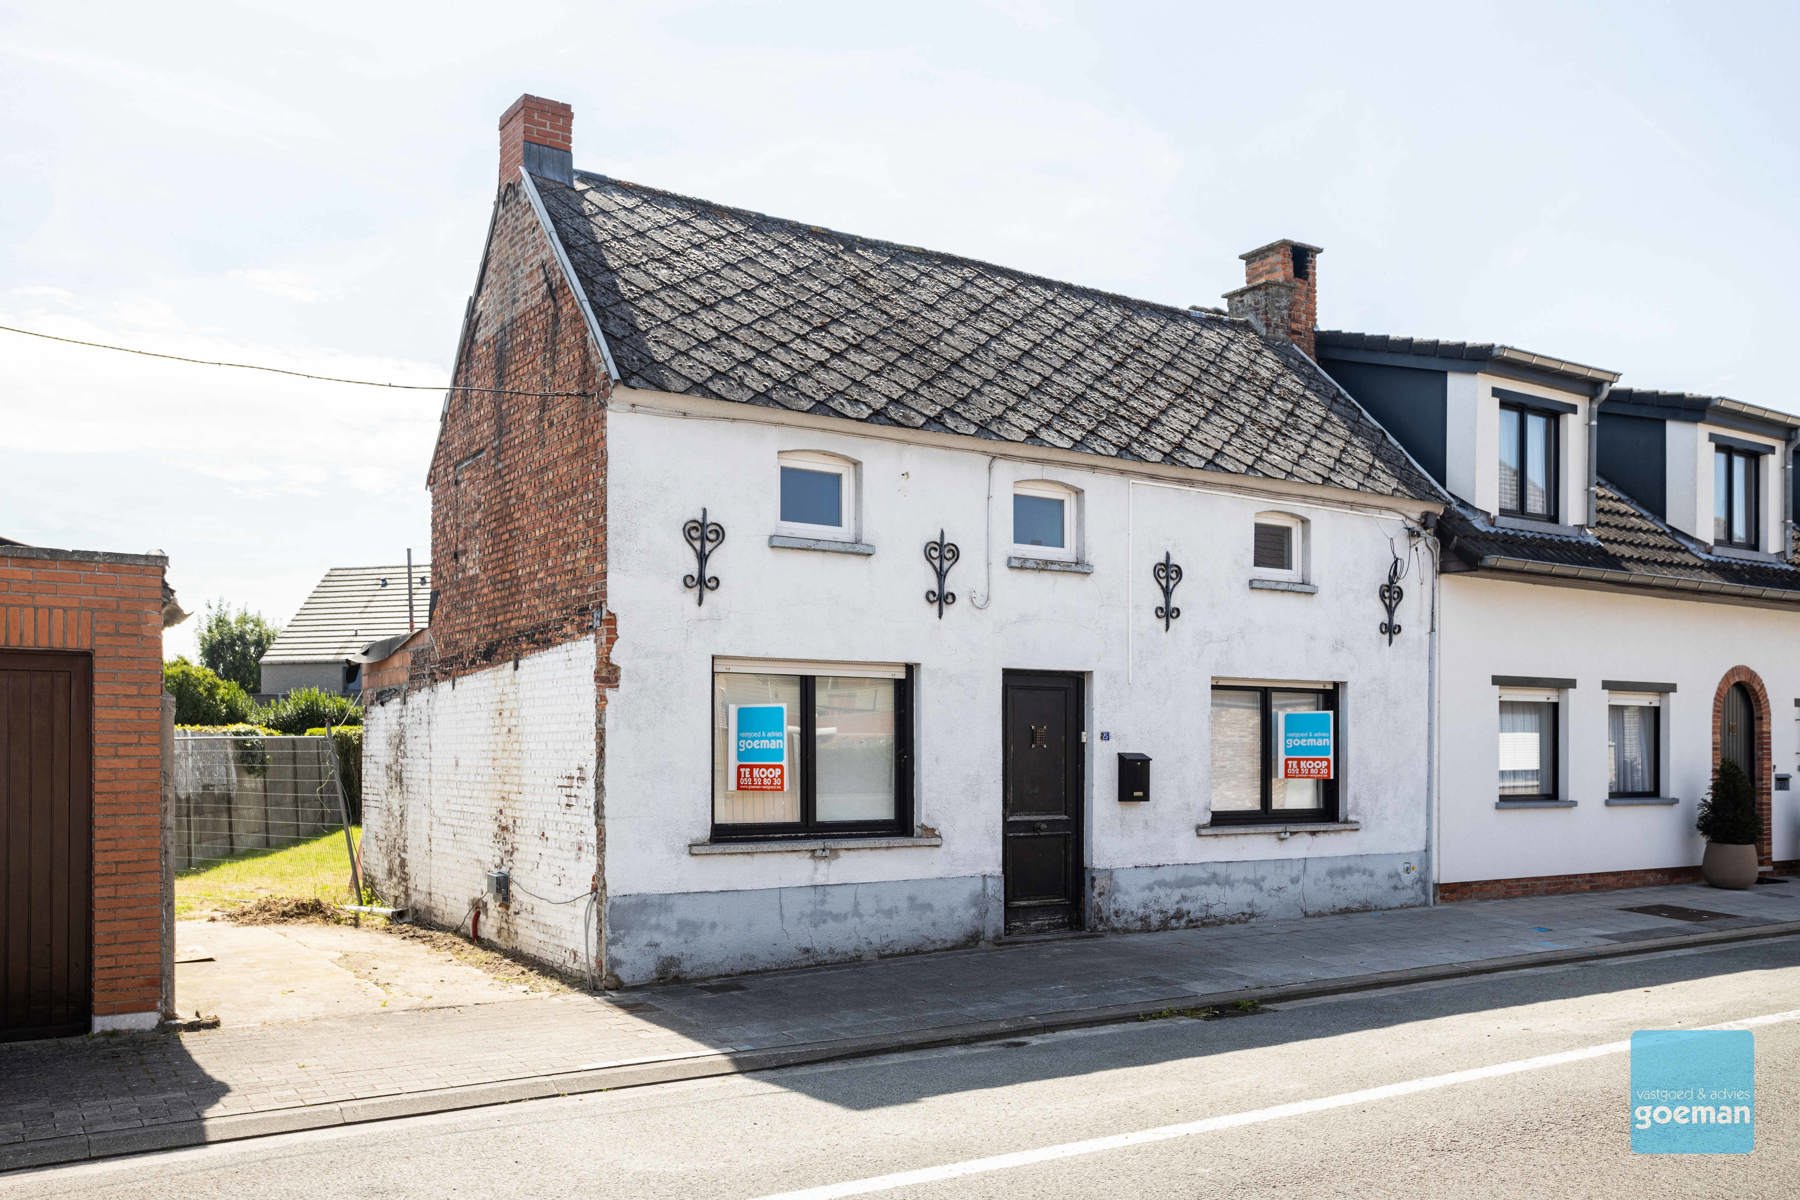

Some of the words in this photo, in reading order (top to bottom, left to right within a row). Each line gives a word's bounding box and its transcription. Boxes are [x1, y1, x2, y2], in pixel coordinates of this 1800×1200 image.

[739, 740, 783, 752] goeman
[1286, 738, 1330, 748] goeman
[1287, 760, 1298, 768] TE
[1300, 760, 1328, 768] KOOP
[740, 768, 750, 778] TE
[753, 768, 782, 778] KOOP
